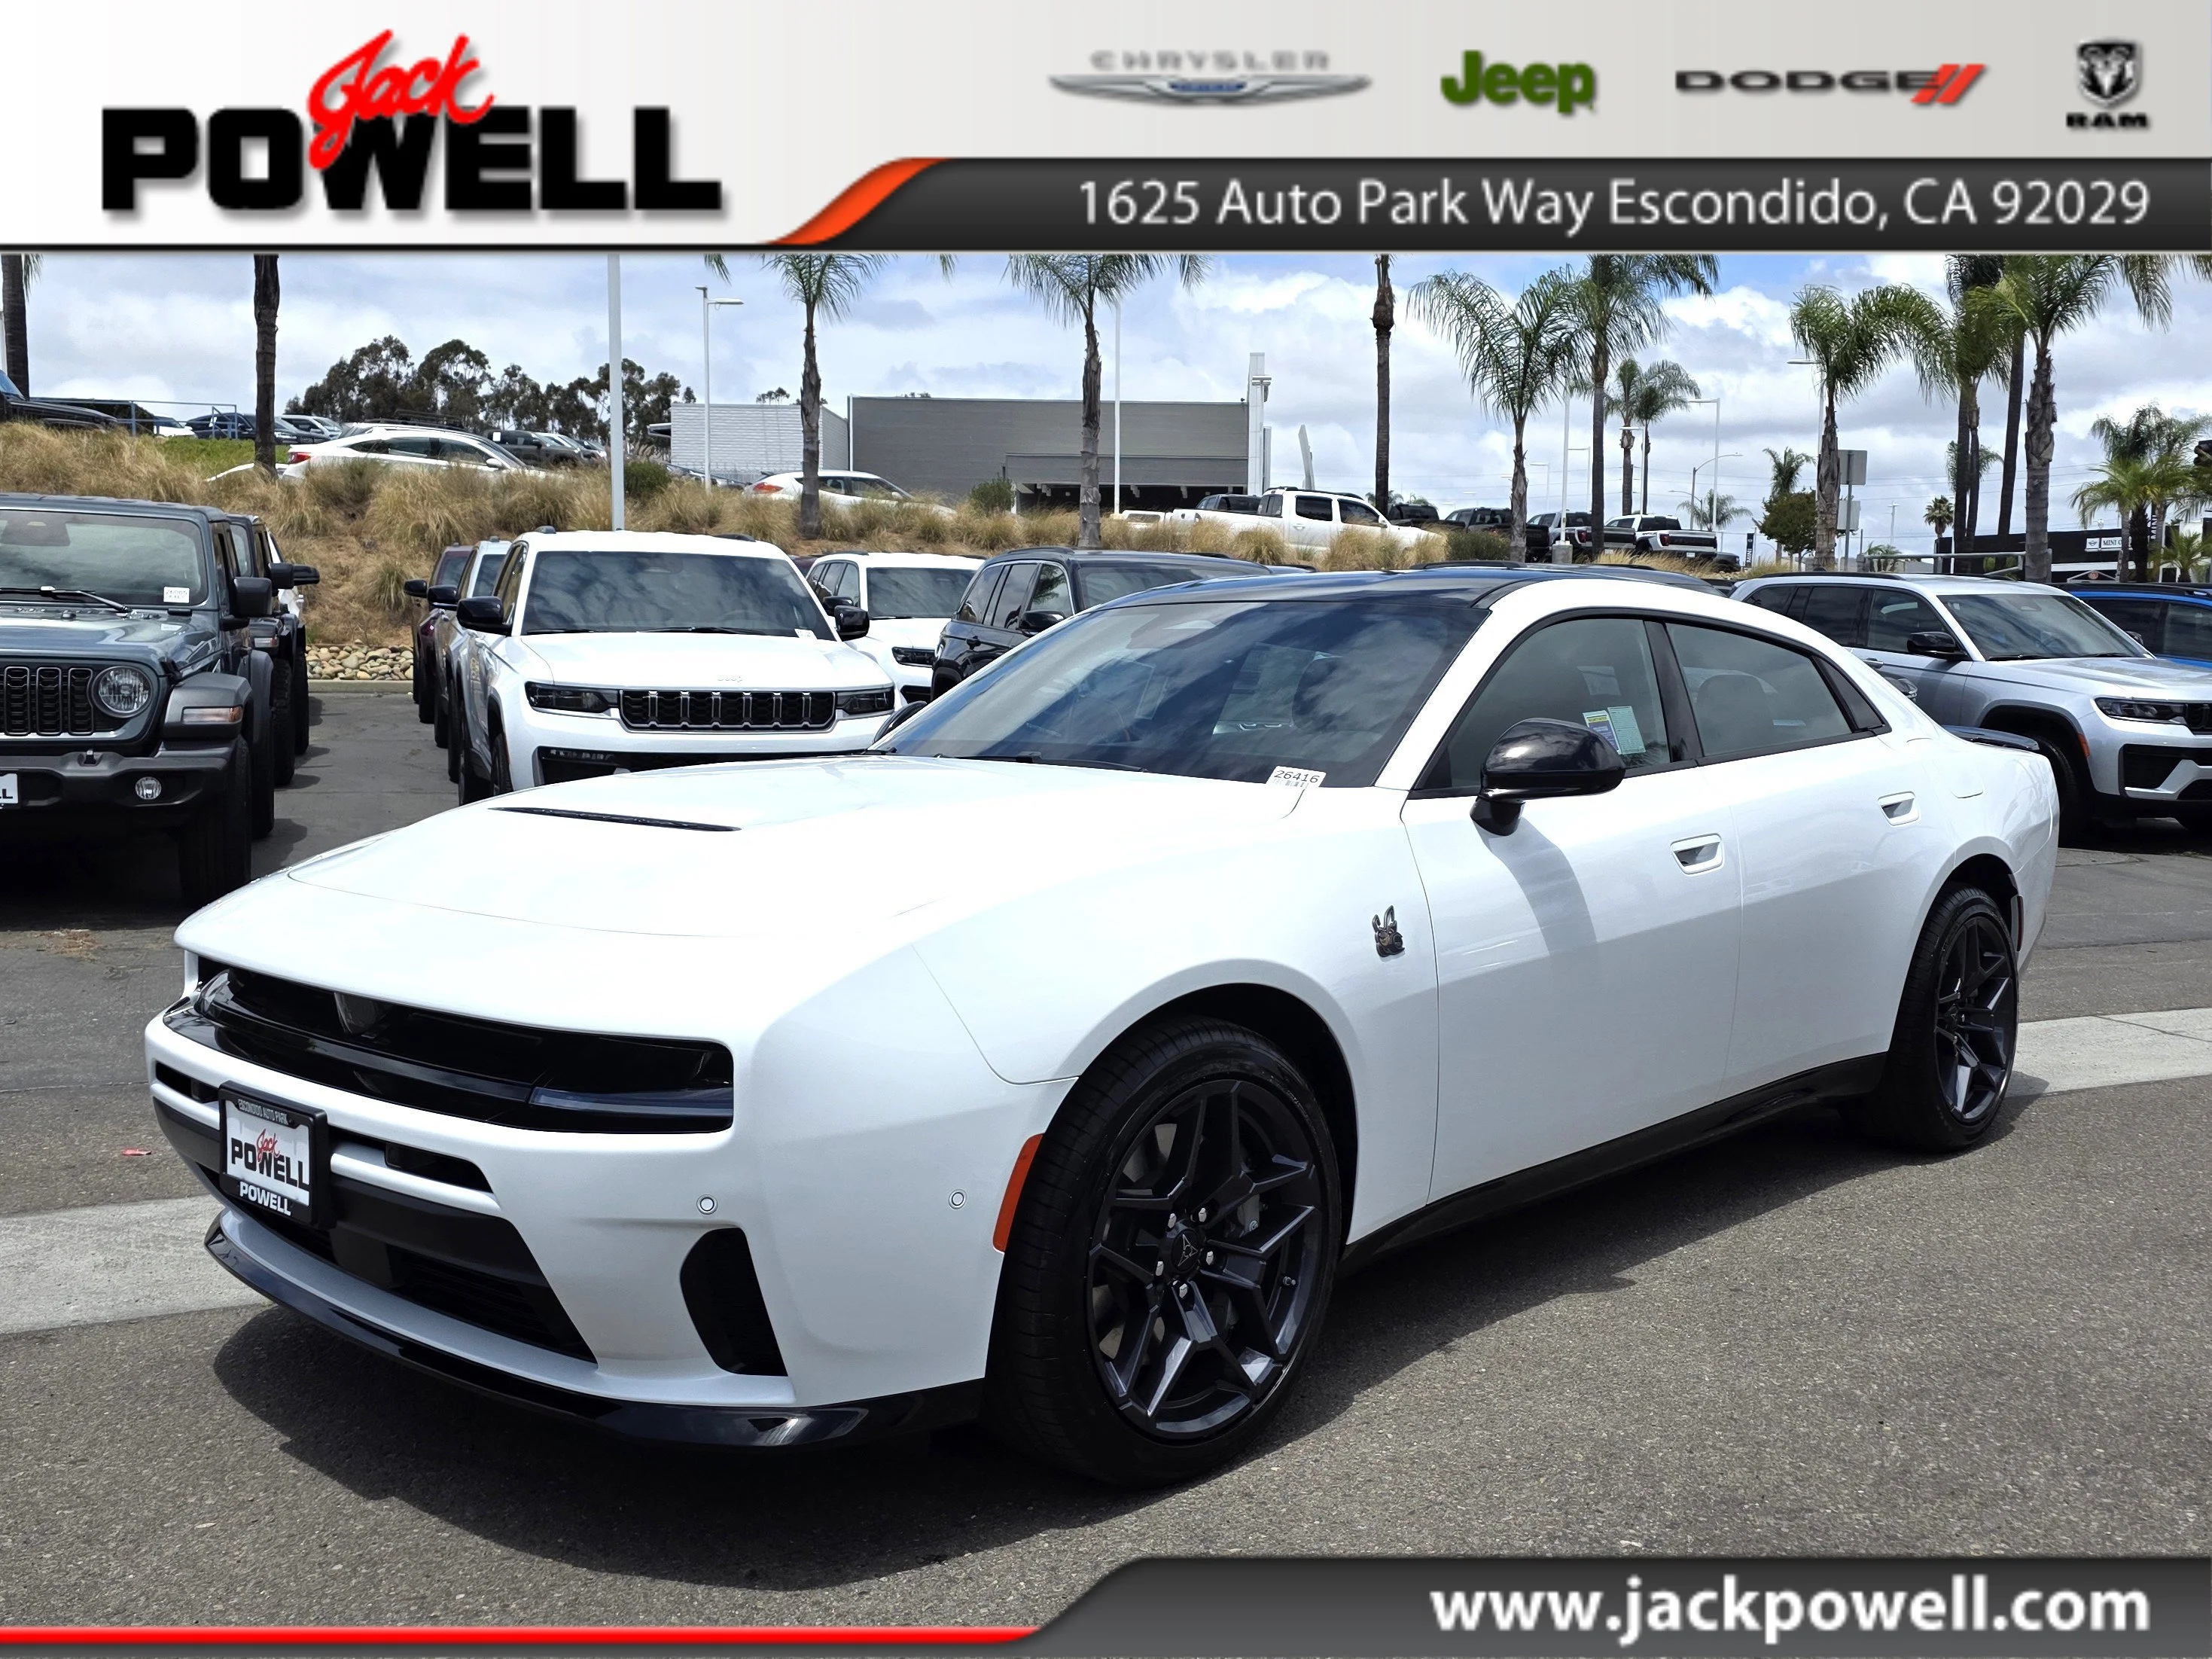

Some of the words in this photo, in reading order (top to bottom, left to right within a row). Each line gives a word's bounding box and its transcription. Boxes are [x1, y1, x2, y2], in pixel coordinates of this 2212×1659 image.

[1274, 770, 1320, 783] 26416
[257, 1128, 280, 1162] Jack
[231, 1137, 309, 1192] POWELL
[239, 1182, 291, 1215] POWELL
